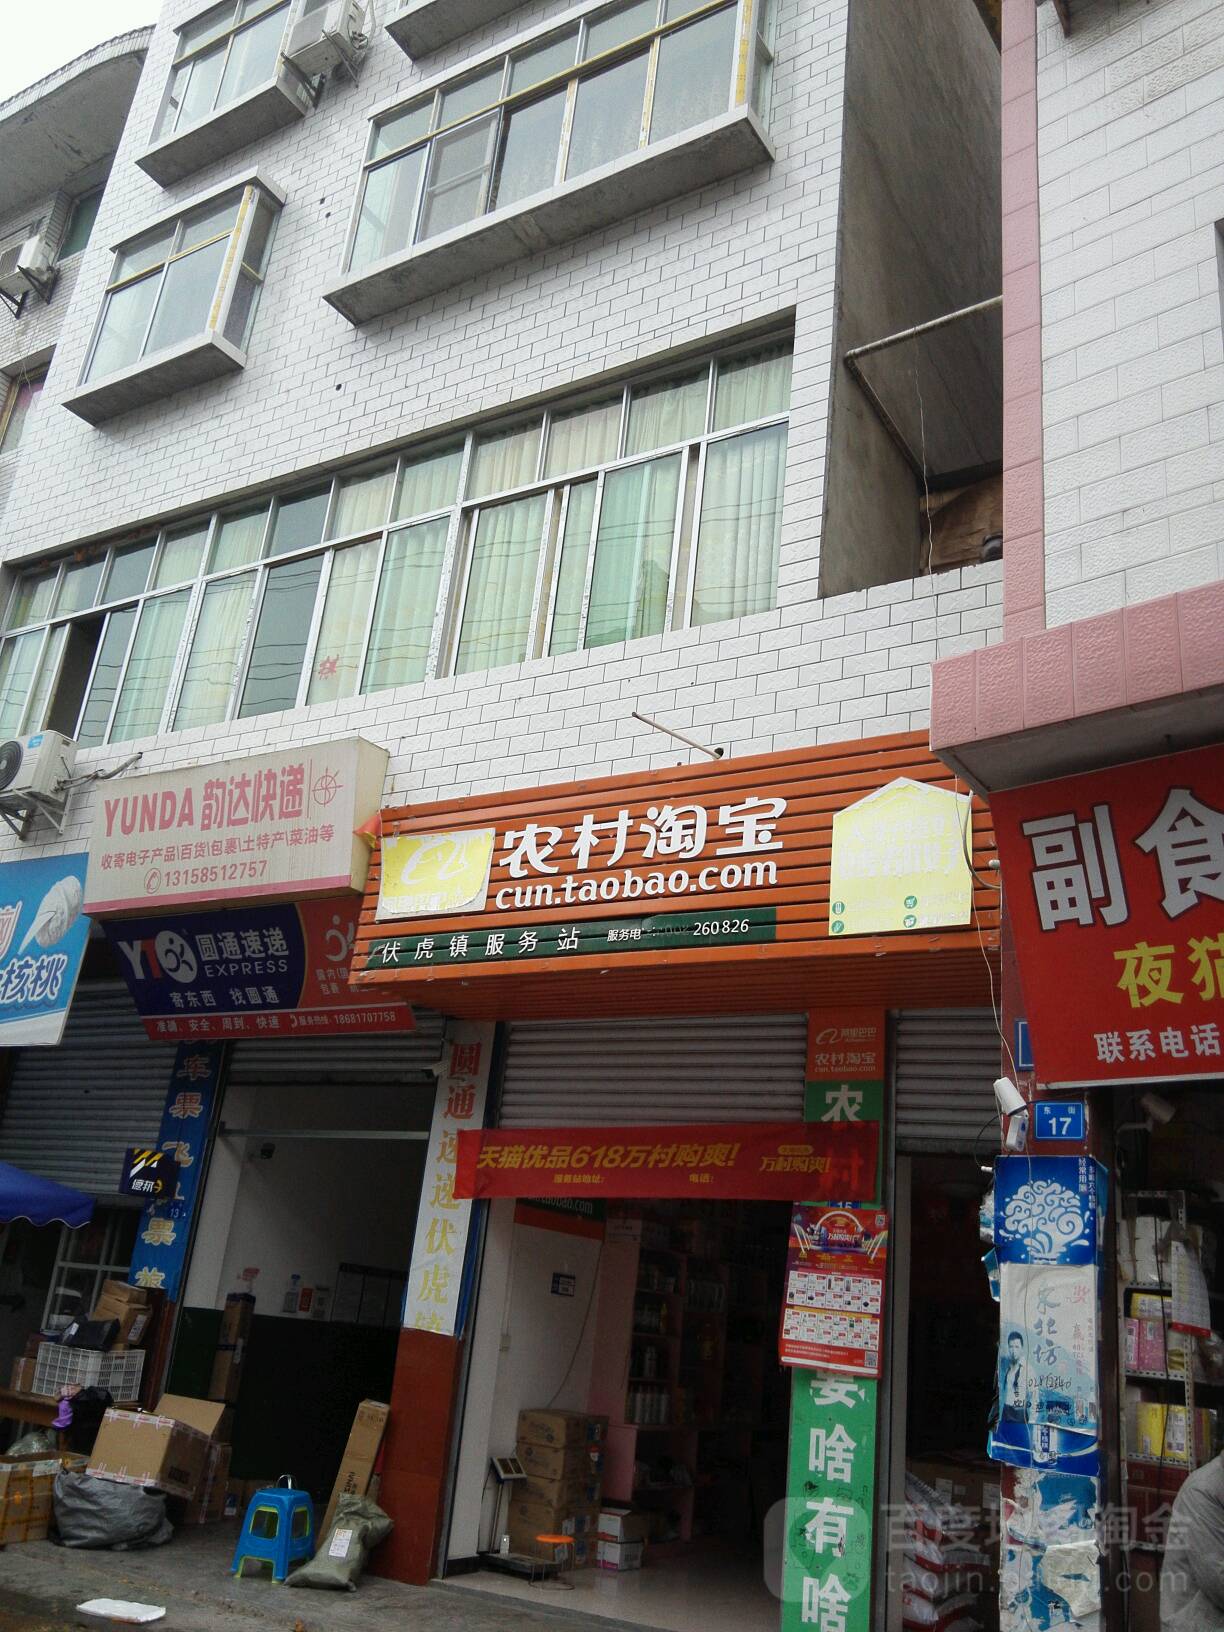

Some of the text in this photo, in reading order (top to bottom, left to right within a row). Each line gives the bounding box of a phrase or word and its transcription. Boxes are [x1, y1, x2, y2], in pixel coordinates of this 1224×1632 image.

[104, 763, 306, 838] YUNDA 韵达快递
[499, 797, 788, 879] 农村淘宝
[164, 860, 268, 889] 13158512757
[496, 859, 778, 910] cun.taobao.com
[199, 927, 290, 963] 圆通速递
[381, 927, 580, 964] 伏虎镇服务站
[0, 955, 68, 1003] 核桃
[204, 959, 289, 979] EXPRESS
[169, 986, 281, 1008] 寄东西 找圆通
[815, 1051, 877, 1066] 农村淘宝
[1094, 1023, 1221, 1064] 联系电话
[1048, 1117, 1072, 1136] 17
[132, 1178, 155, 1193] 德邦
